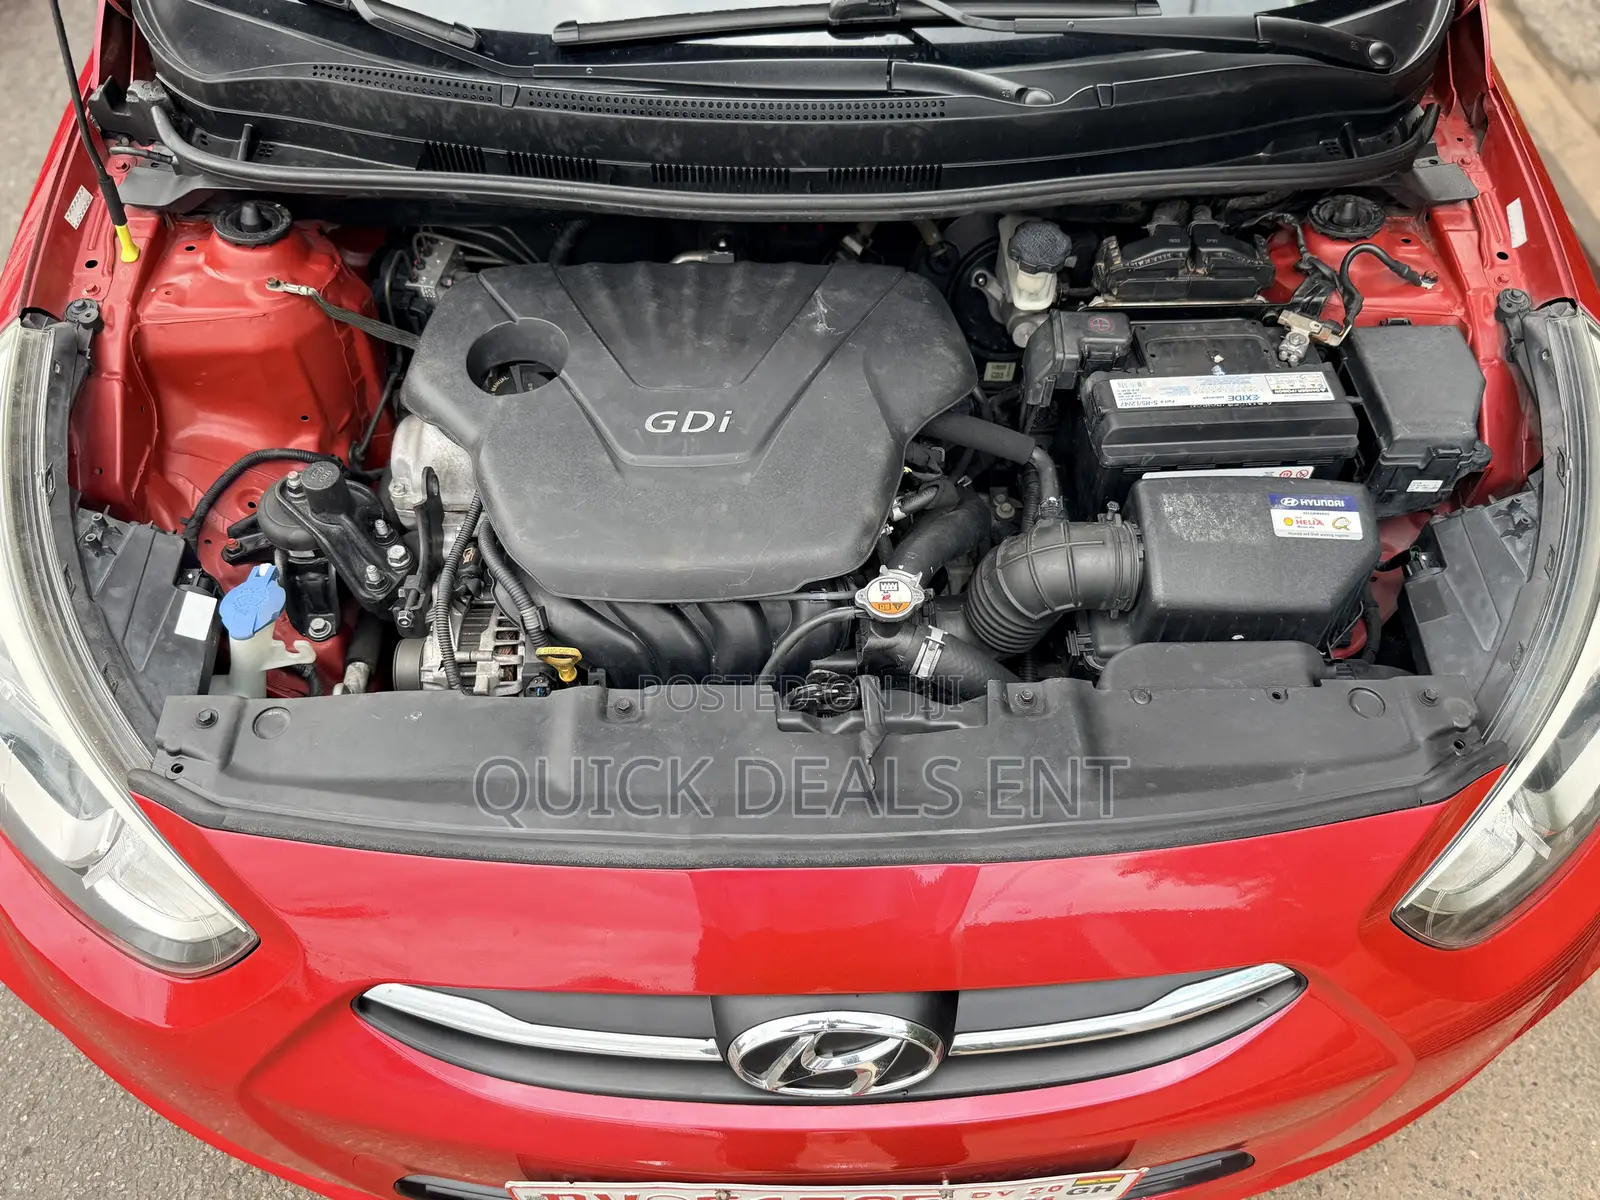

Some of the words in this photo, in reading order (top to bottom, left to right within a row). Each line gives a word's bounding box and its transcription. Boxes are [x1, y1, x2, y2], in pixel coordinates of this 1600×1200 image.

[644, 410, 733, 433] GDi
[1300, 498, 1345, 508] HYUNDAI
[1295, 517, 1325, 526] HELIX
[971, 1189, 1015, 1199] DV
[1029, 1185, 1064, 1195] 20
[1066, 1184, 1117, 1196] GH
